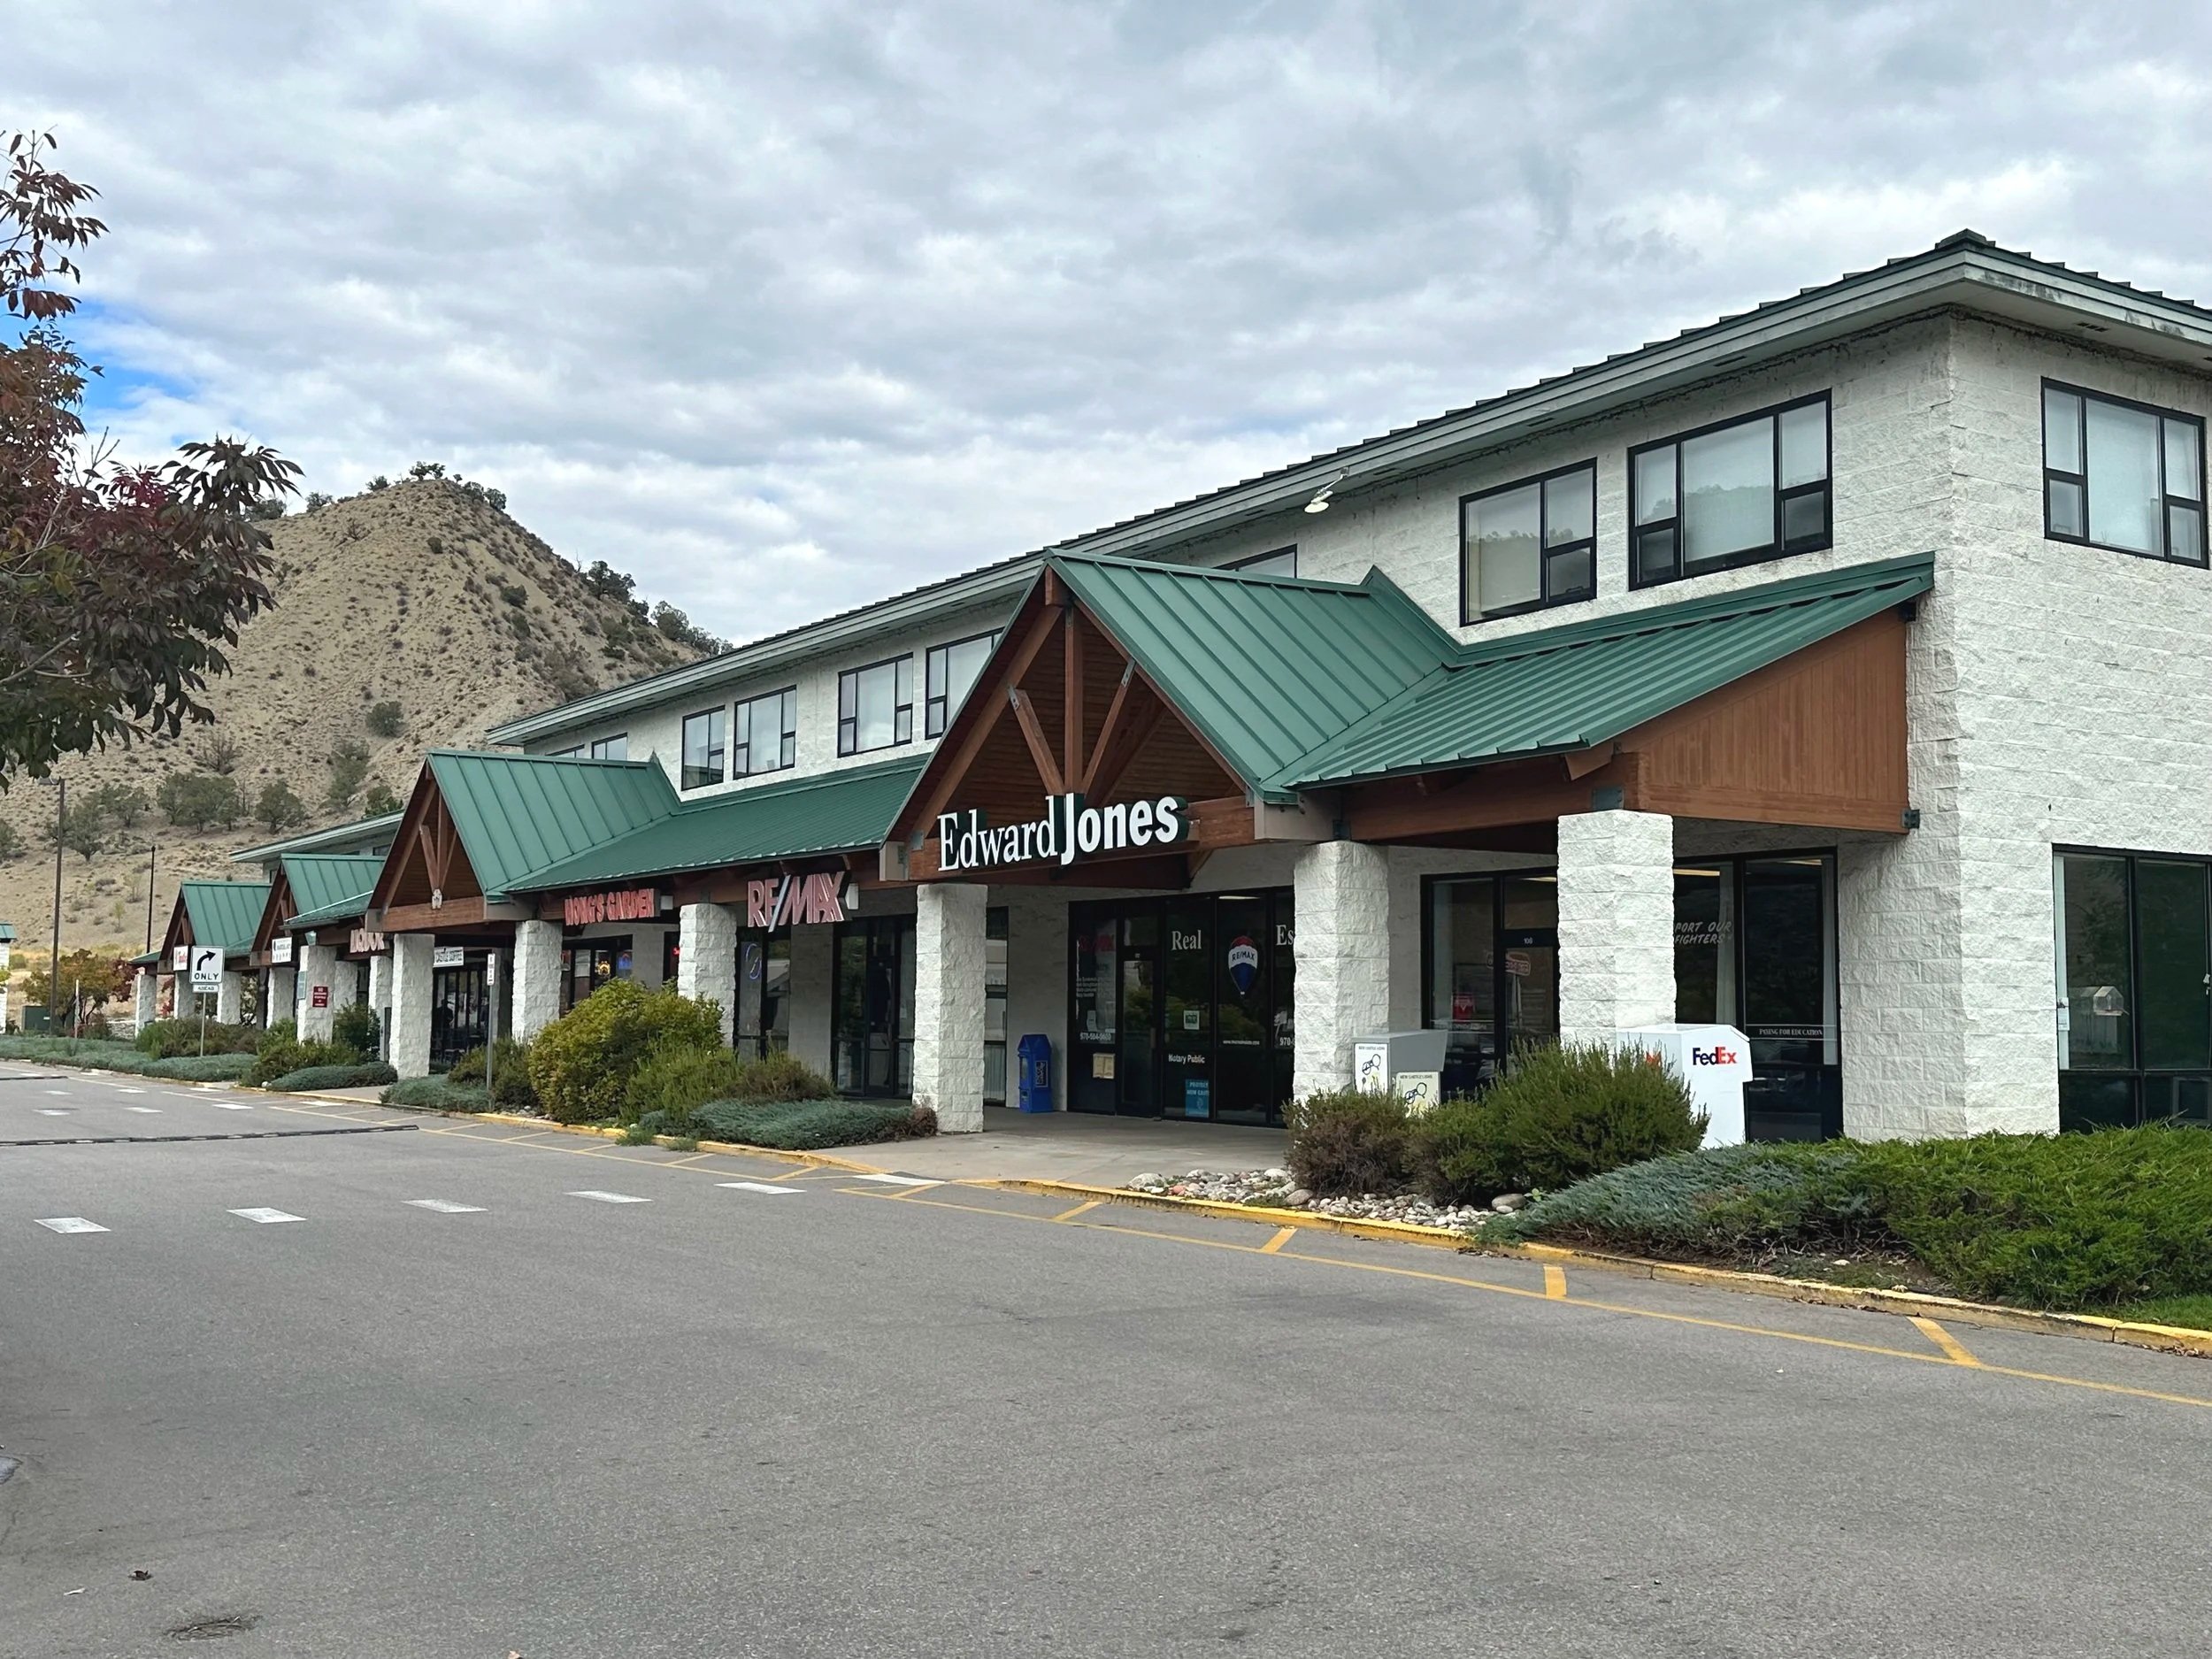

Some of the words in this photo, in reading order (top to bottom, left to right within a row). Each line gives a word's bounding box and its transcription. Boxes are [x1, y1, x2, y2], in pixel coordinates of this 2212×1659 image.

[937, 795, 1057, 872] Edward
[1061, 793, 1179, 865] Jones
[606, 888, 655, 921] GARDEN
[748, 871, 846, 933] RE/MAX
[1674, 922, 1703, 933] PORT
[1708, 921, 1732, 932] OUR
[349, 928, 385, 953] LIQUOR
[1171, 929, 1202, 950] Real
[1674, 933, 1725, 944] FIGHTERS
[1232, 950, 1255, 962] RE/MAX
[1168, 1054, 1187, 1064] Notary
[1187, 1054, 1205, 1064] Public
[1693, 1046, 1738, 1065] FedEx
